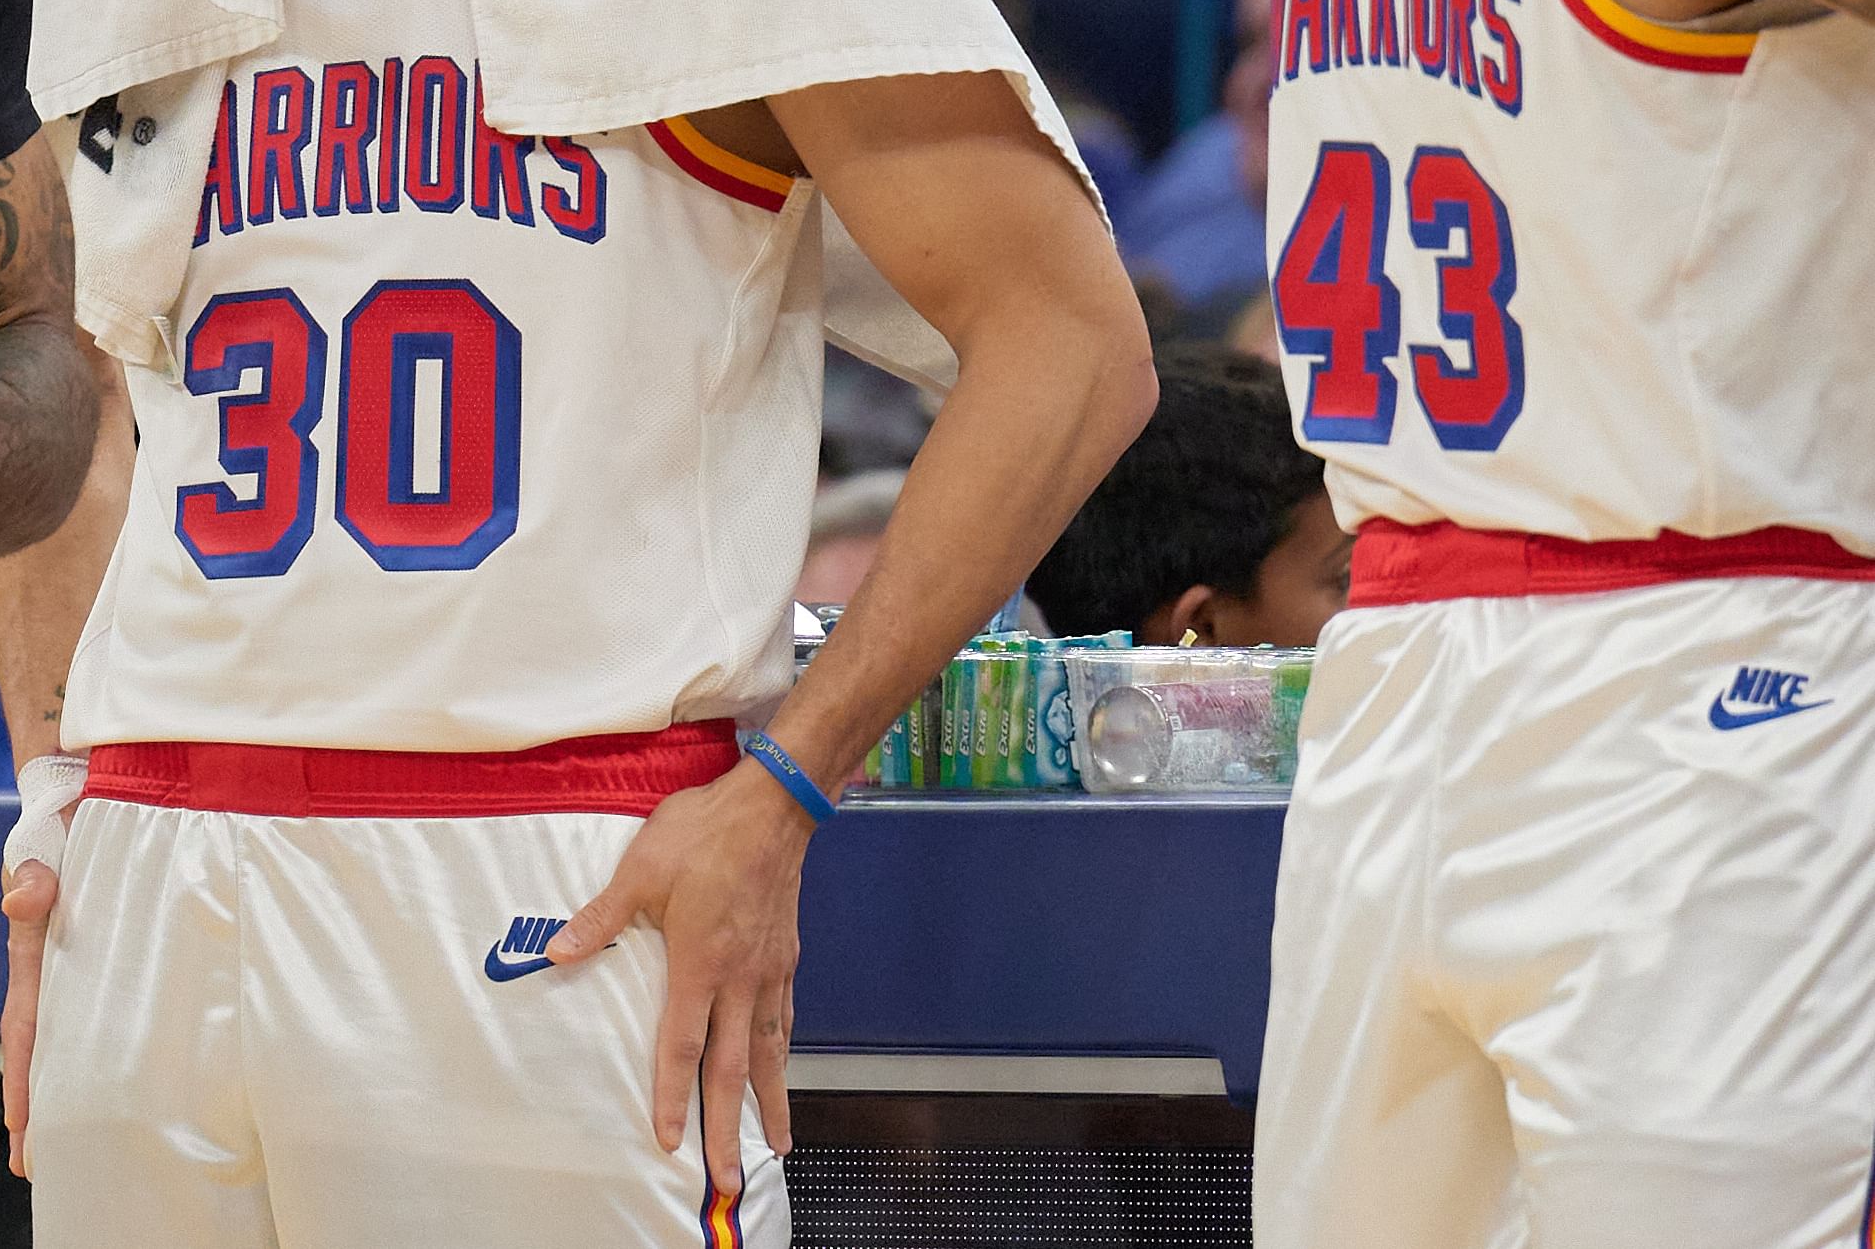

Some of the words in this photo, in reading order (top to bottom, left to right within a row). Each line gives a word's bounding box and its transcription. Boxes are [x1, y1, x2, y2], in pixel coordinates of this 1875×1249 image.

[192, 55, 607, 244] ARRIORS
[1272, 141, 1525, 451] 43
[175, 279, 522, 580] 30
[1728, 666, 1808, 708] NIKE
[501, 916, 568, 955] NIK
